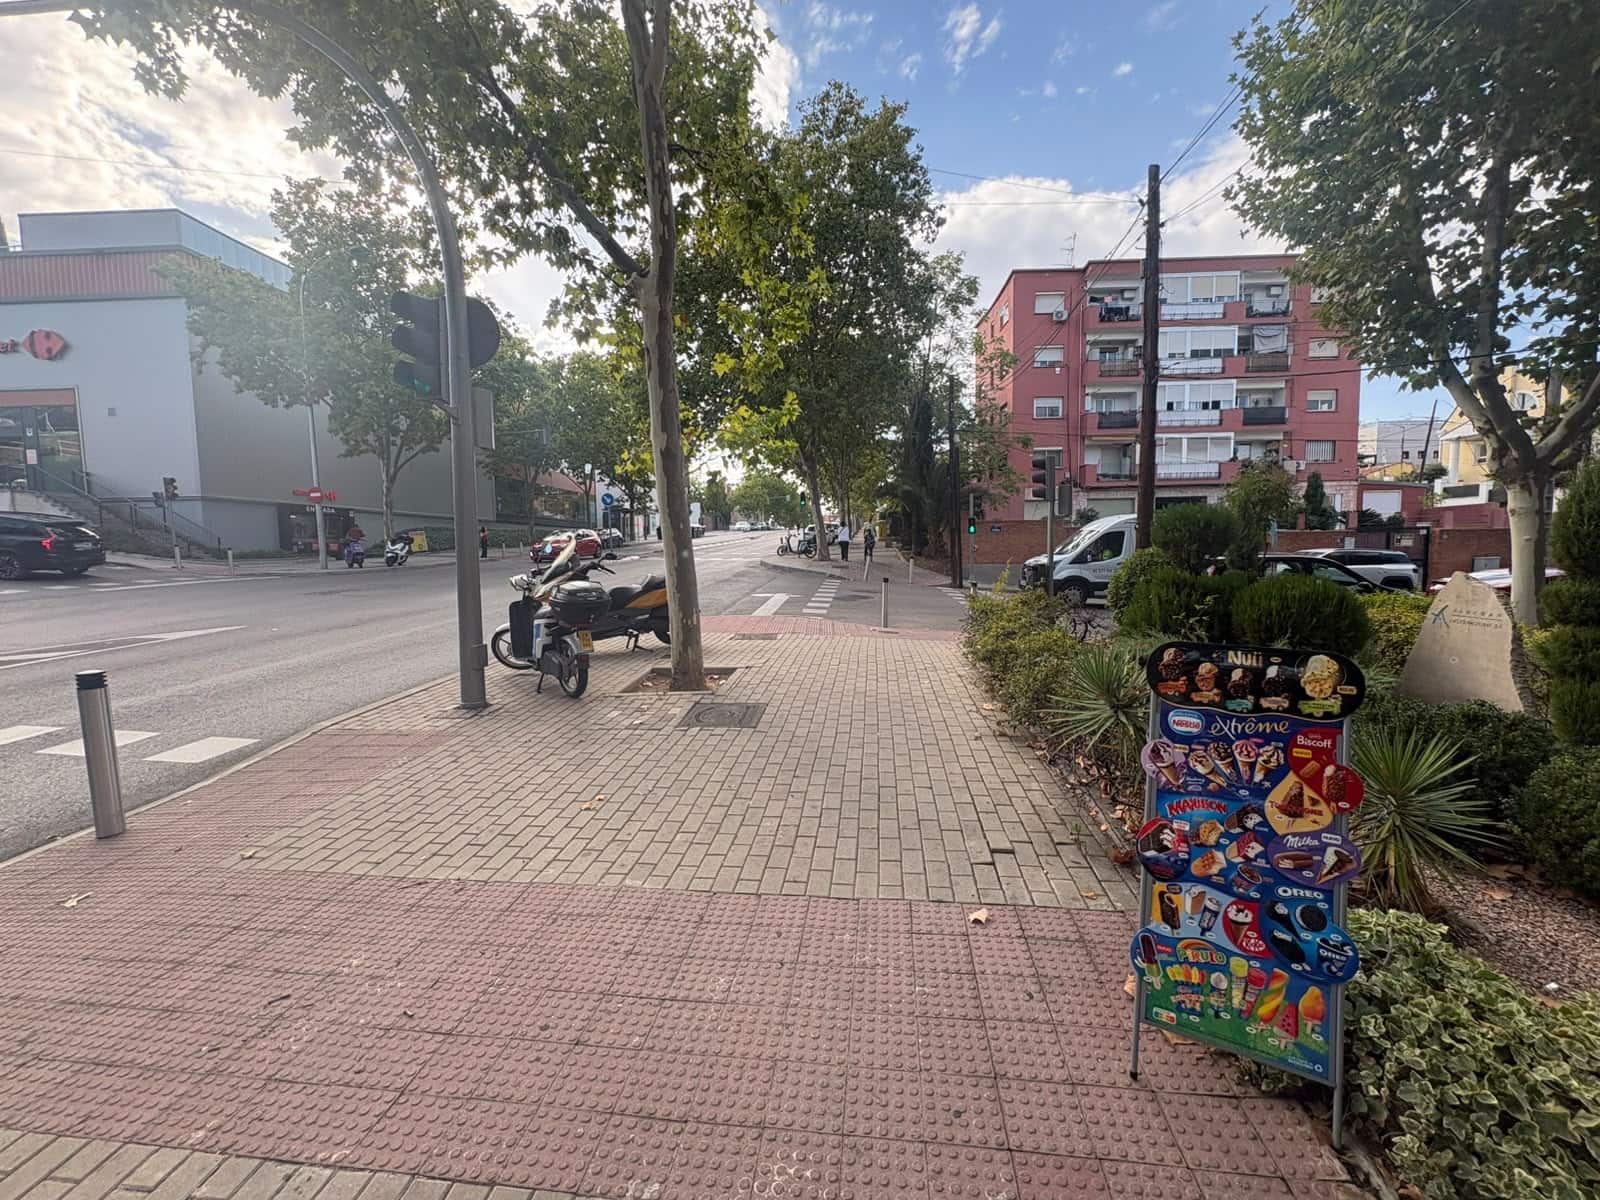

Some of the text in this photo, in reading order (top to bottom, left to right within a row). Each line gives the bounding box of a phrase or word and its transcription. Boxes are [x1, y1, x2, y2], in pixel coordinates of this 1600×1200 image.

[305, 505, 337, 514] ENADA
[1227, 650, 1264, 667] Nuii
[1172, 718, 1202, 731] Nestlé
[1296, 734, 1333, 749] Biscoff
[1283, 834, 1321, 849] Milka
[1276, 886, 1325, 899] OREO
